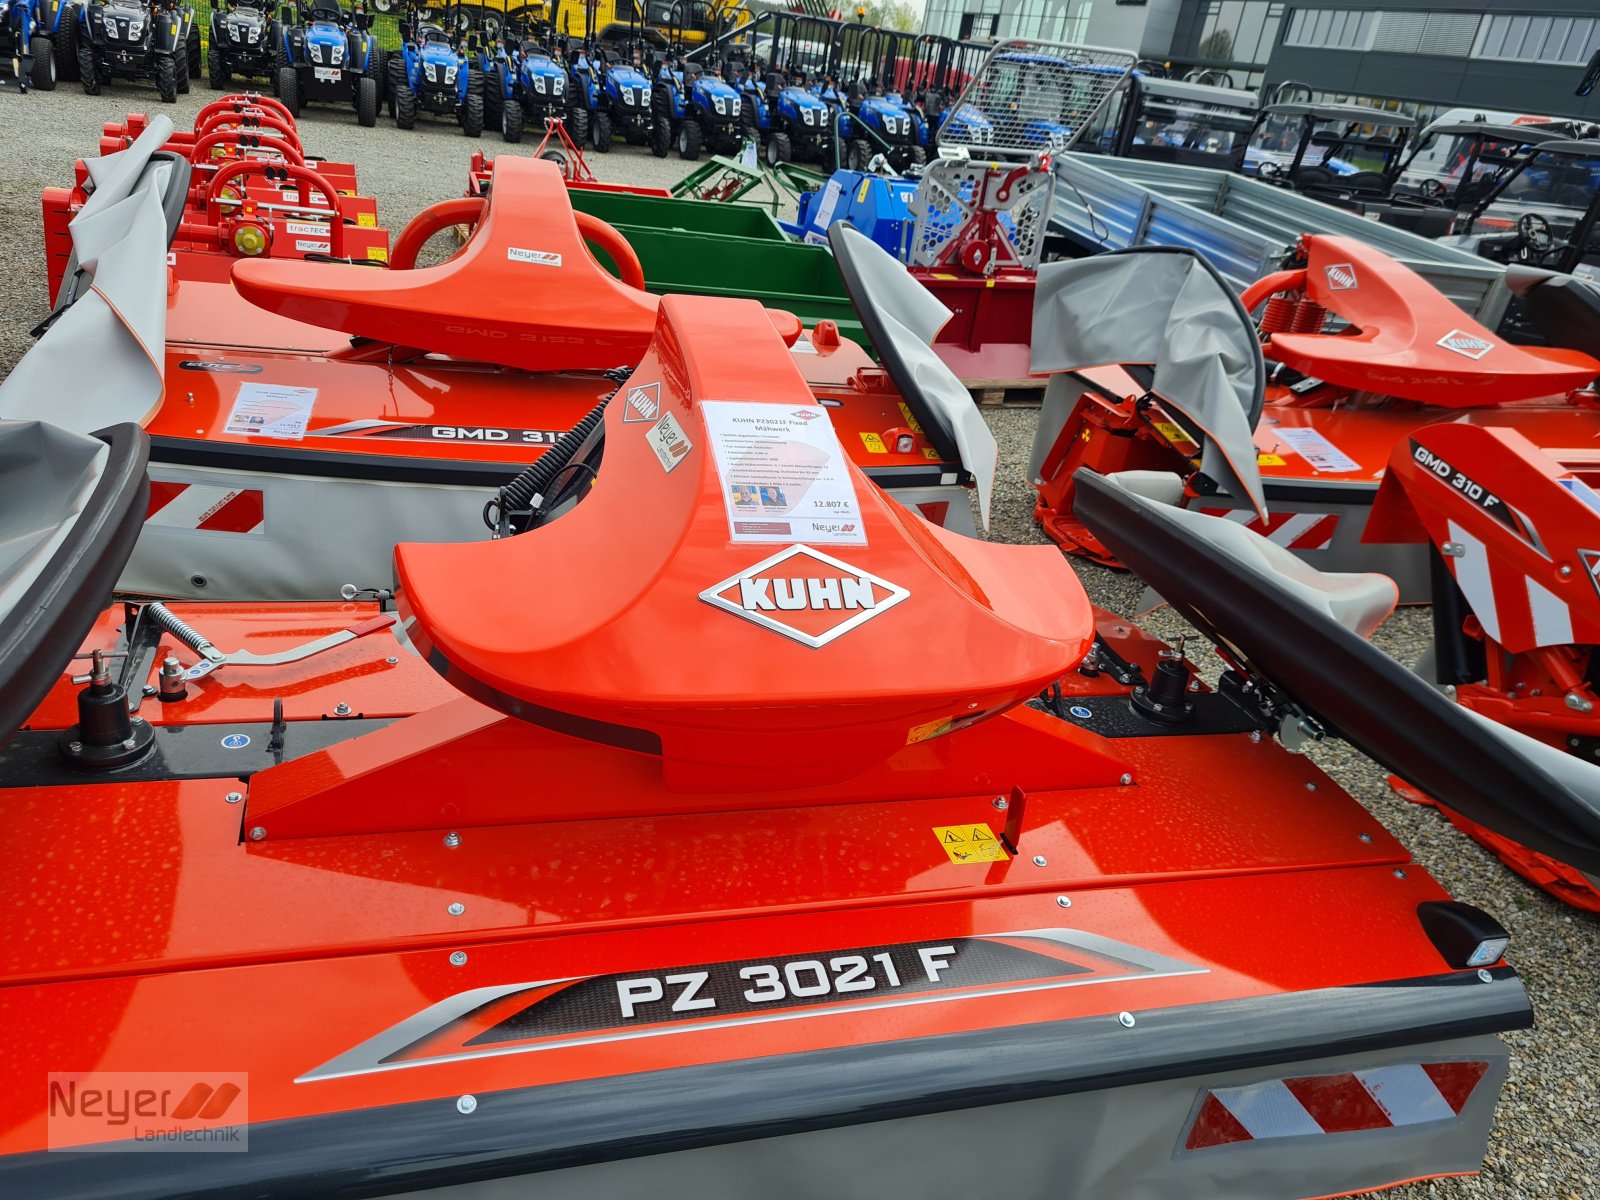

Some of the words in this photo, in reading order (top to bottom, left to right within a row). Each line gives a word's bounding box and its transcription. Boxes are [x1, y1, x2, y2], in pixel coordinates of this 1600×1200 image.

[290, 225, 325, 234] tracTEC
[509, 248, 541, 259] Neyer
[1327, 266, 1355, 288] KUHN
[1446, 337, 1488, 350] KUHN
[628, 388, 657, 419] KUHN
[431, 426, 509, 441] GMD
[657, 414, 678, 447] Neyer
[754, 424, 791, 432] Mähwerk
[1414, 446, 1451, 477] GMD
[1452, 472, 1483, 500] 310
[1483, 494, 1500, 507] F
[814, 500, 841, 508] 12.807
[812, 522, 840, 533] Neyer
[739, 577, 877, 611] KUHN
[616, 971, 716, 1018] PZ
[739, 952, 901, 1003] 3021
[917, 945, 956, 982] F
